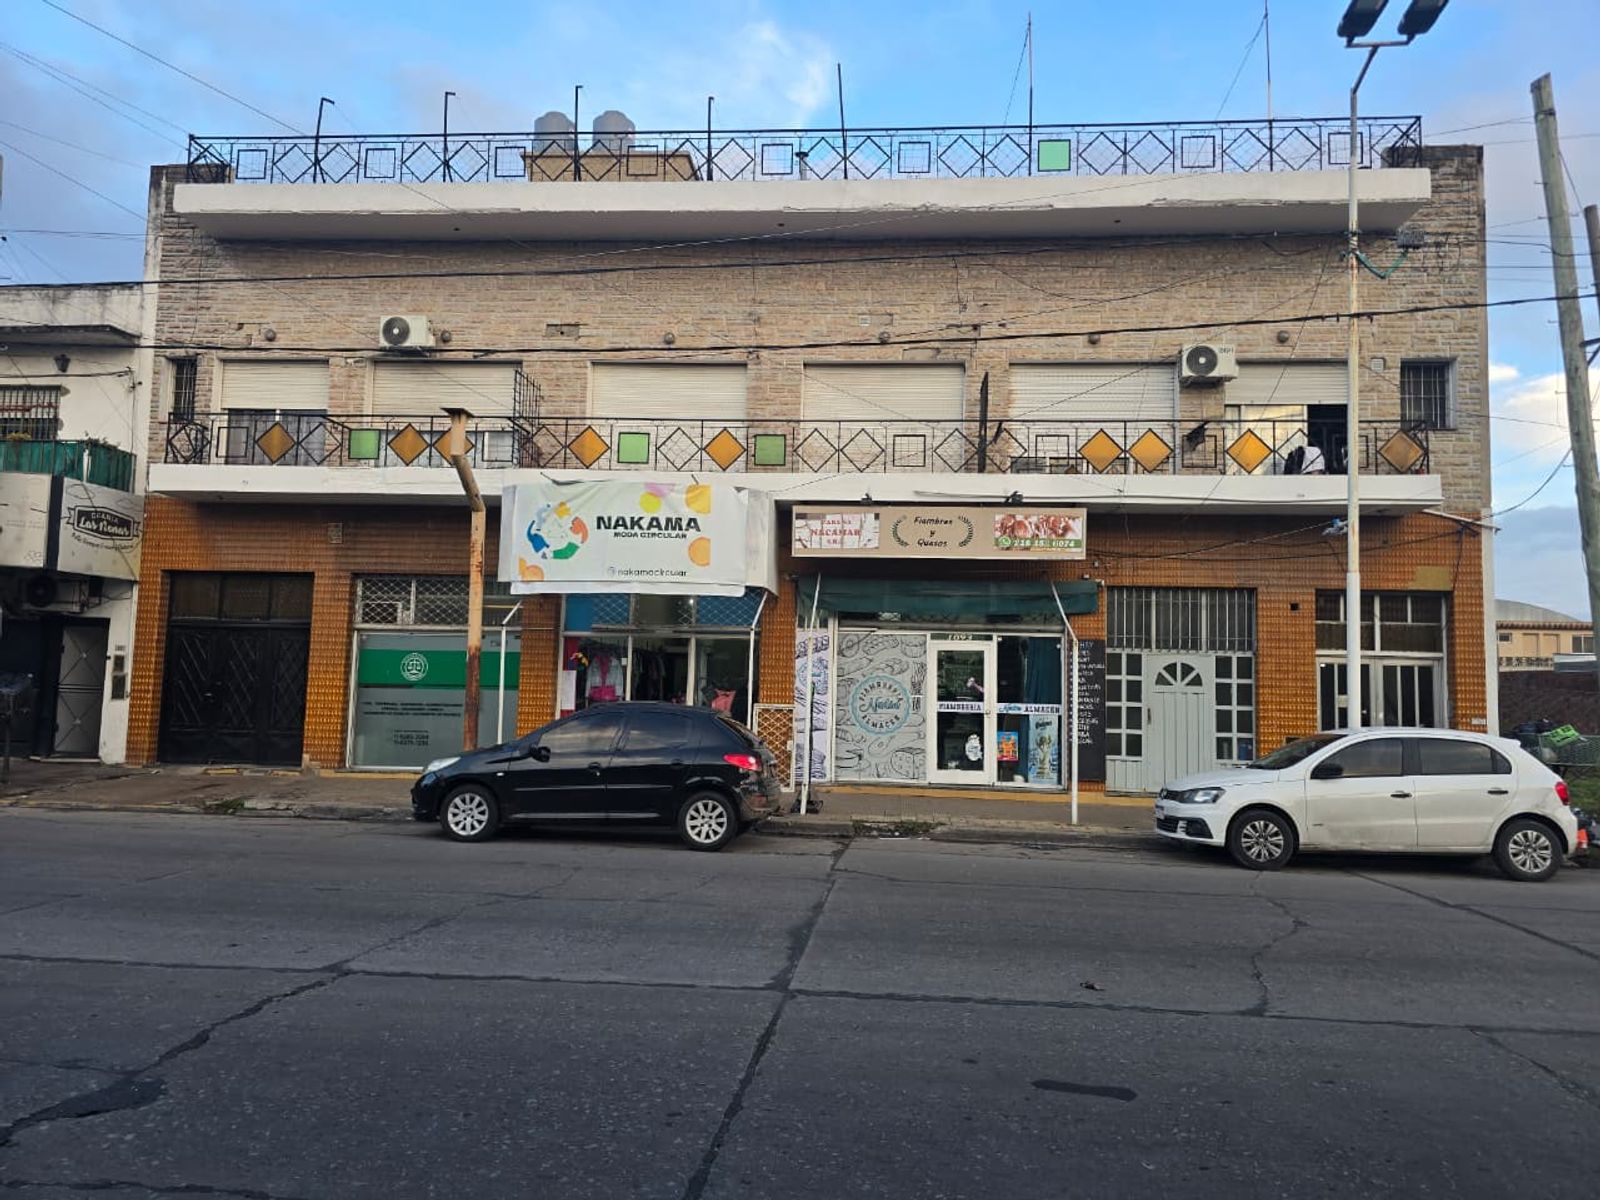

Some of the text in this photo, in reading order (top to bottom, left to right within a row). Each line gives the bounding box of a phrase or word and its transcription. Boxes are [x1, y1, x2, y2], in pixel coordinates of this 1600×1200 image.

[596, 515, 702, 533] NAKAMA
[914, 515, 953, 525] Fiambres
[613, 531, 688, 540] MODA CIRCULAR
[930, 529, 936, 538] y
